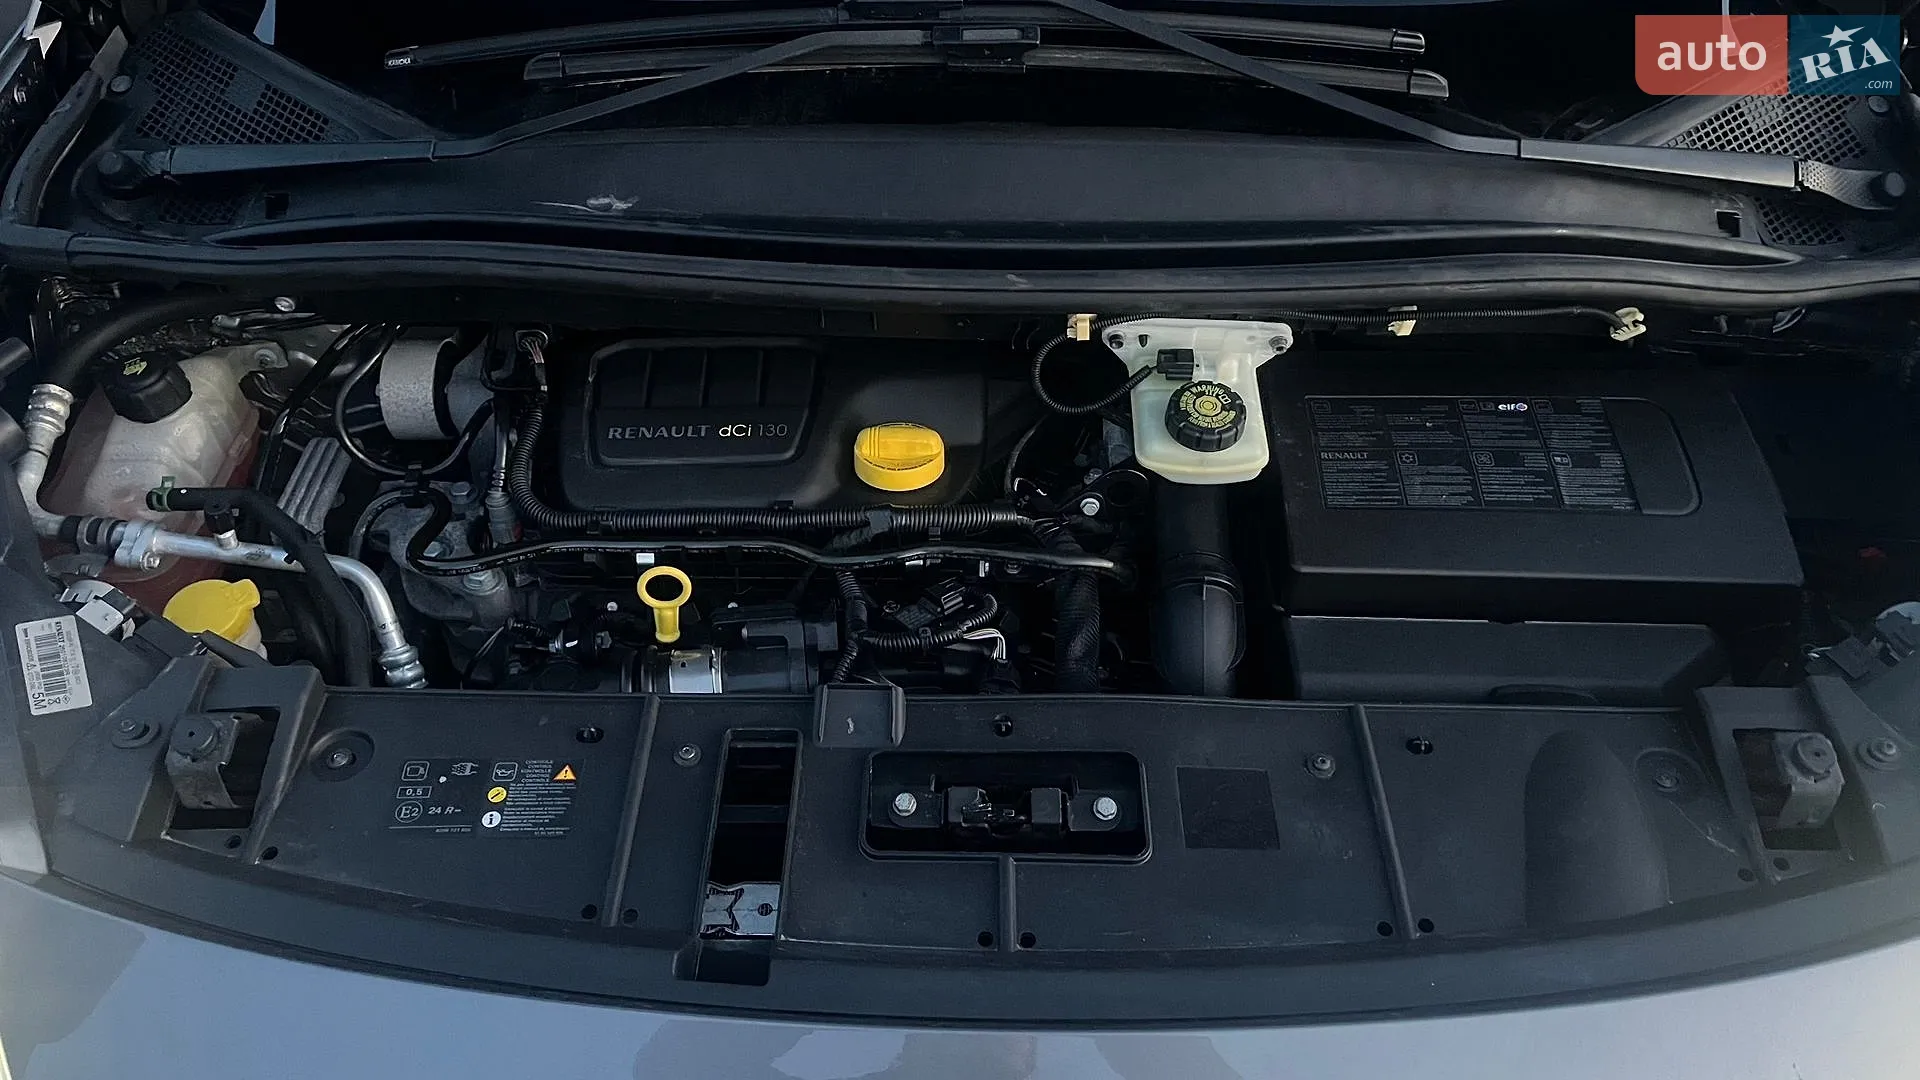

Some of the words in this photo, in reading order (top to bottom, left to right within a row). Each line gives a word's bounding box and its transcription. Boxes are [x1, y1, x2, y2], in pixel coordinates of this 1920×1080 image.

[607, 425, 710, 439] RENAULT
[718, 424, 752, 437] dCi
[758, 424, 788, 437] 130
[1320, 451, 1369, 460] RENAULT
[32, 692, 47, 710] 5M
[406, 788, 423, 796] 0,5
[399, 806, 419, 818] E2
[428, 806, 442, 815] 24
